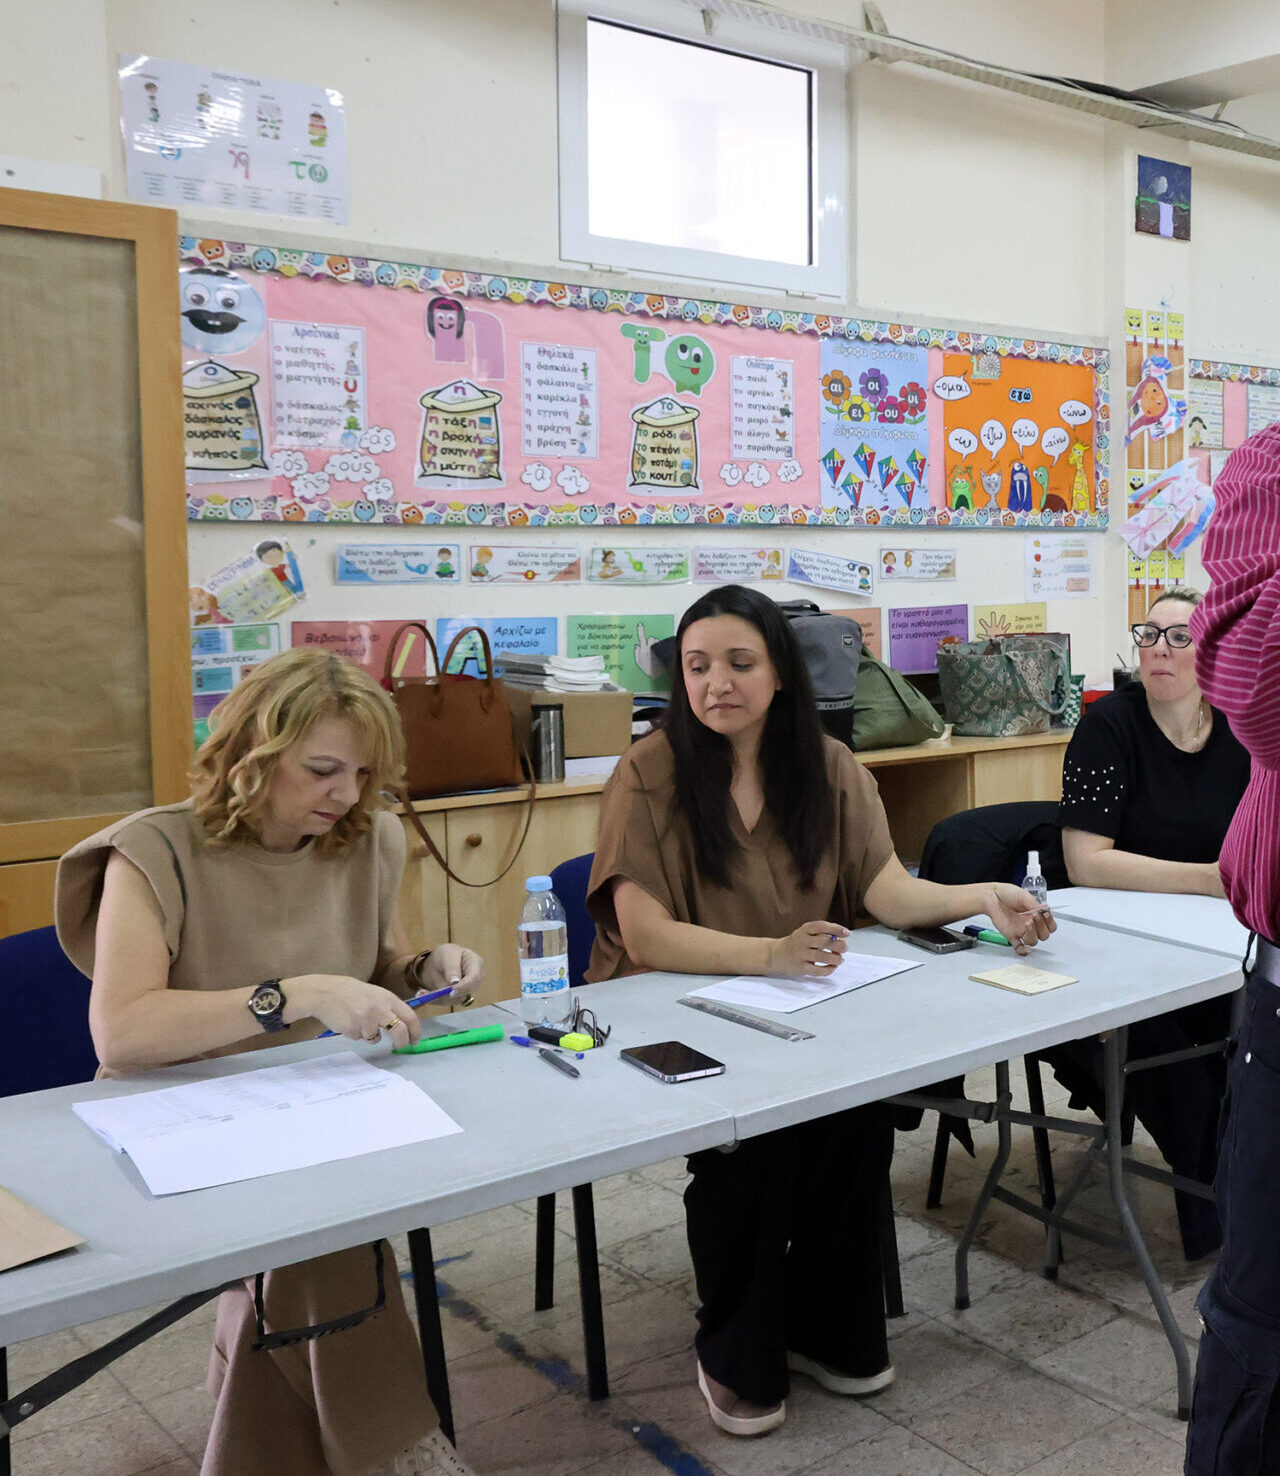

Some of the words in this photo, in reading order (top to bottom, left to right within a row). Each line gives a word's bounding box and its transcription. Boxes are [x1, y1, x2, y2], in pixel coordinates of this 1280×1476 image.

[537, 347, 574, 360] Θηλυκά
[186, 428, 241, 441] ουρανός
[494, 625, 533, 636] Αρχίζω
[534, 627, 546, 635] με
[494, 639, 540, 649] κεφαλαίο
